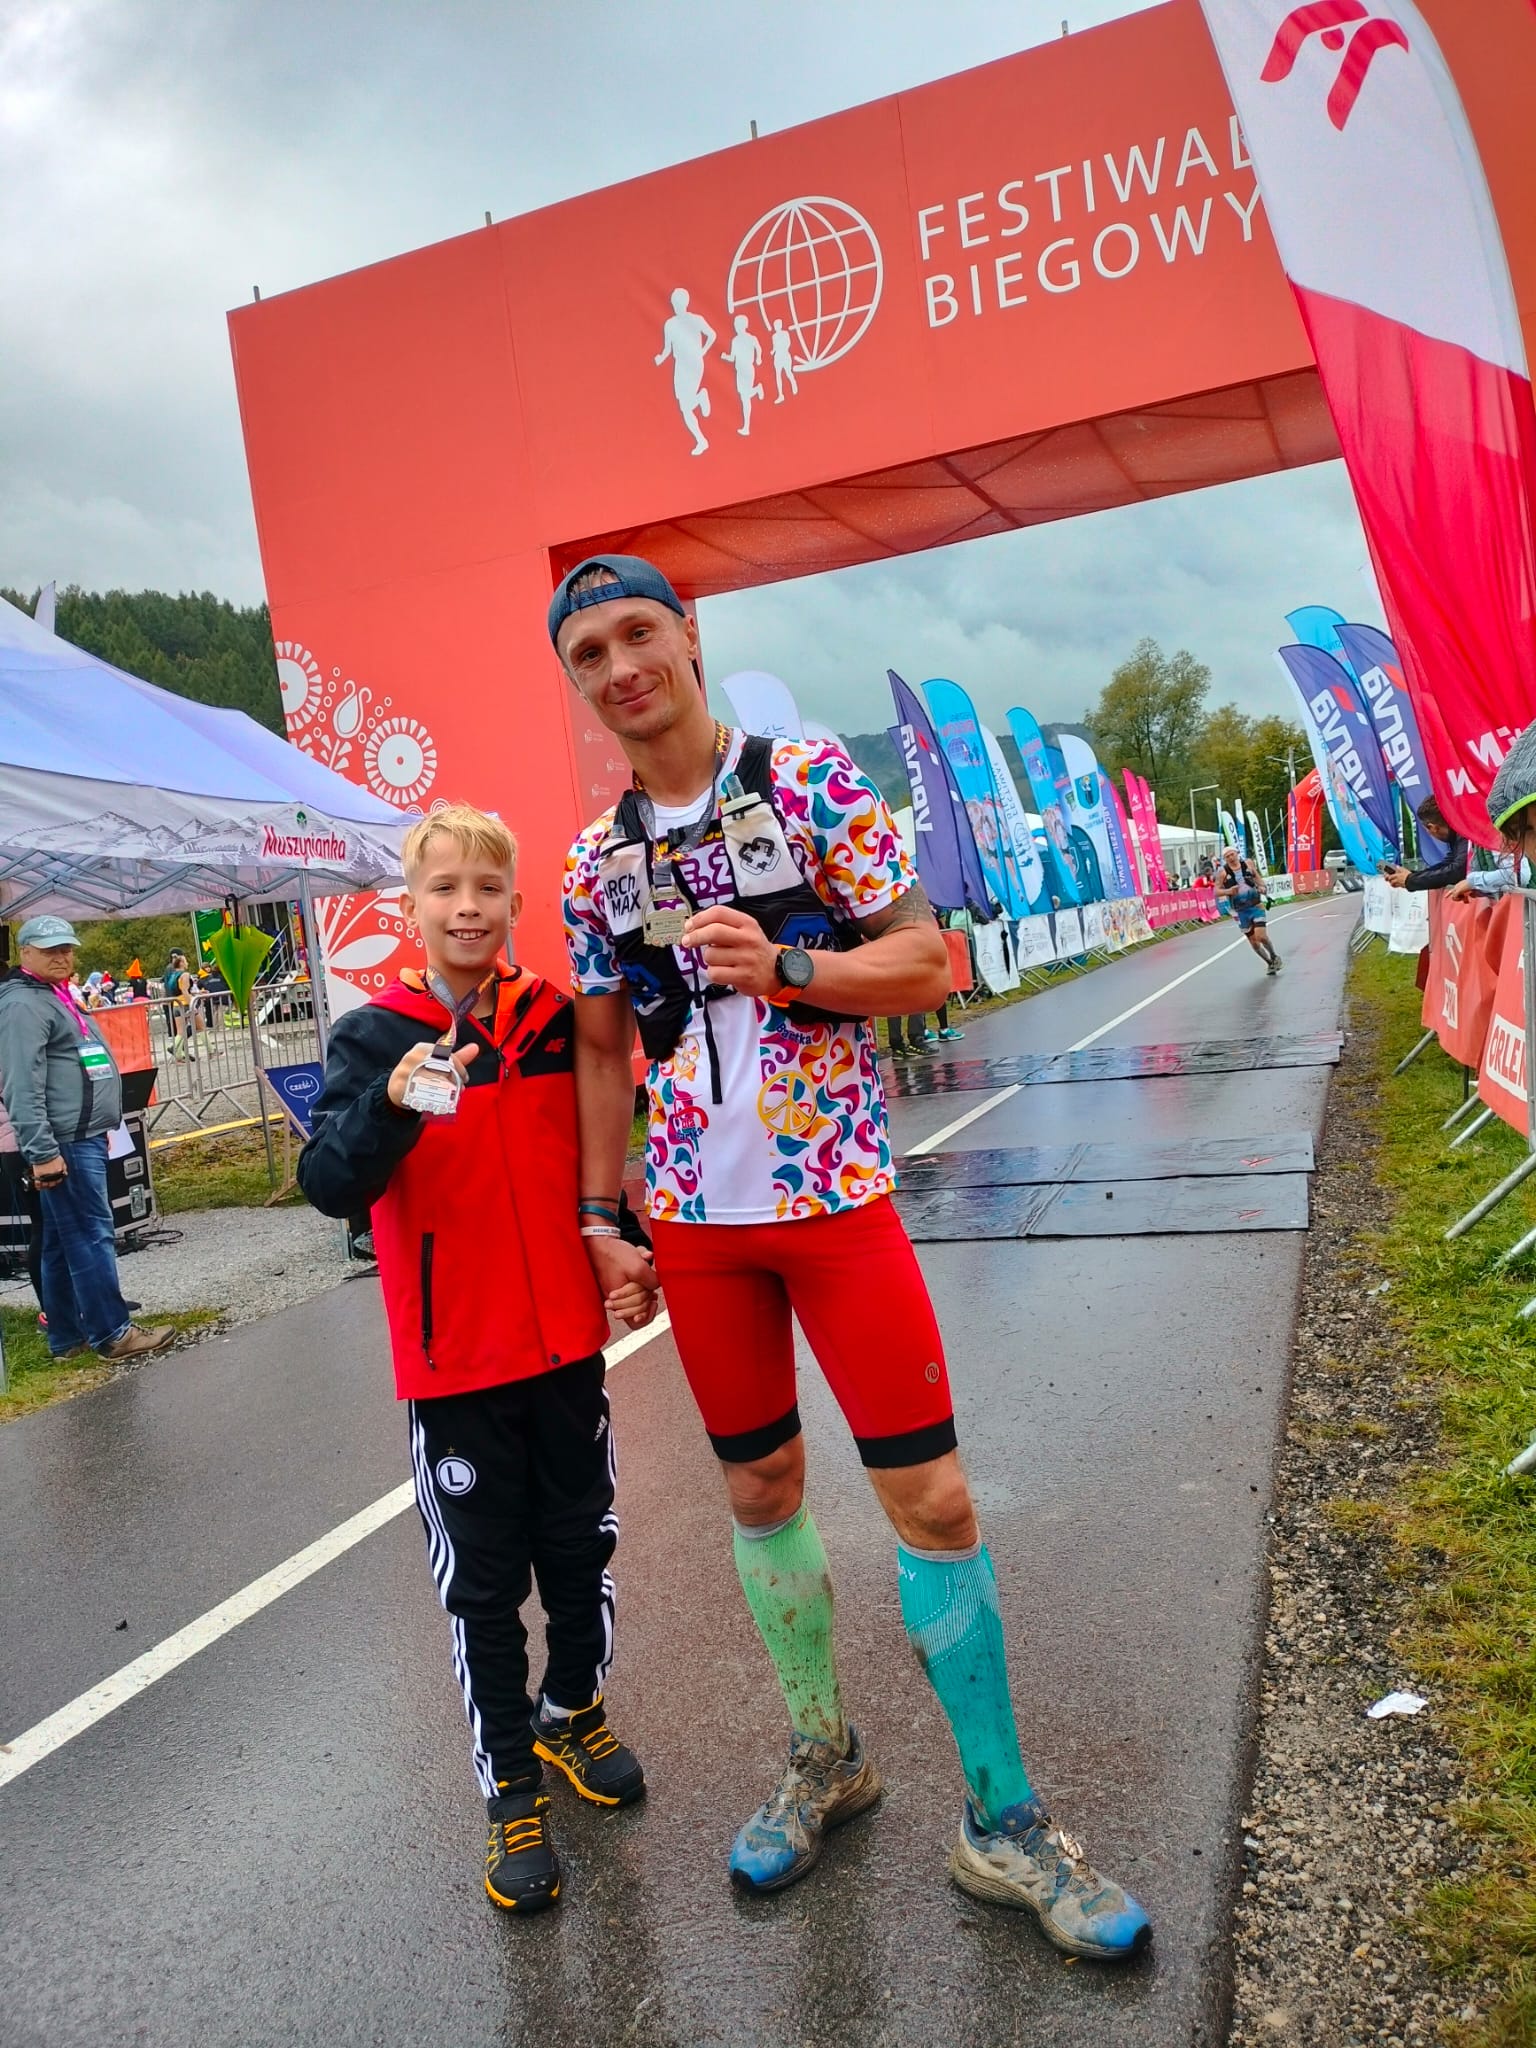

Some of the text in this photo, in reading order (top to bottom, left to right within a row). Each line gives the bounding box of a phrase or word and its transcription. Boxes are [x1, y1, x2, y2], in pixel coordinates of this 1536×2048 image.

[918, 115, 1252, 261] FESTIWAL
[925, 184, 1261, 328] BIEGOWY
[262, 825, 346, 866] Muszynianka
[611, 890, 641, 918] MAX
[776, 1022, 812, 1045] Bartka
[447, 1465, 464, 1486] L
